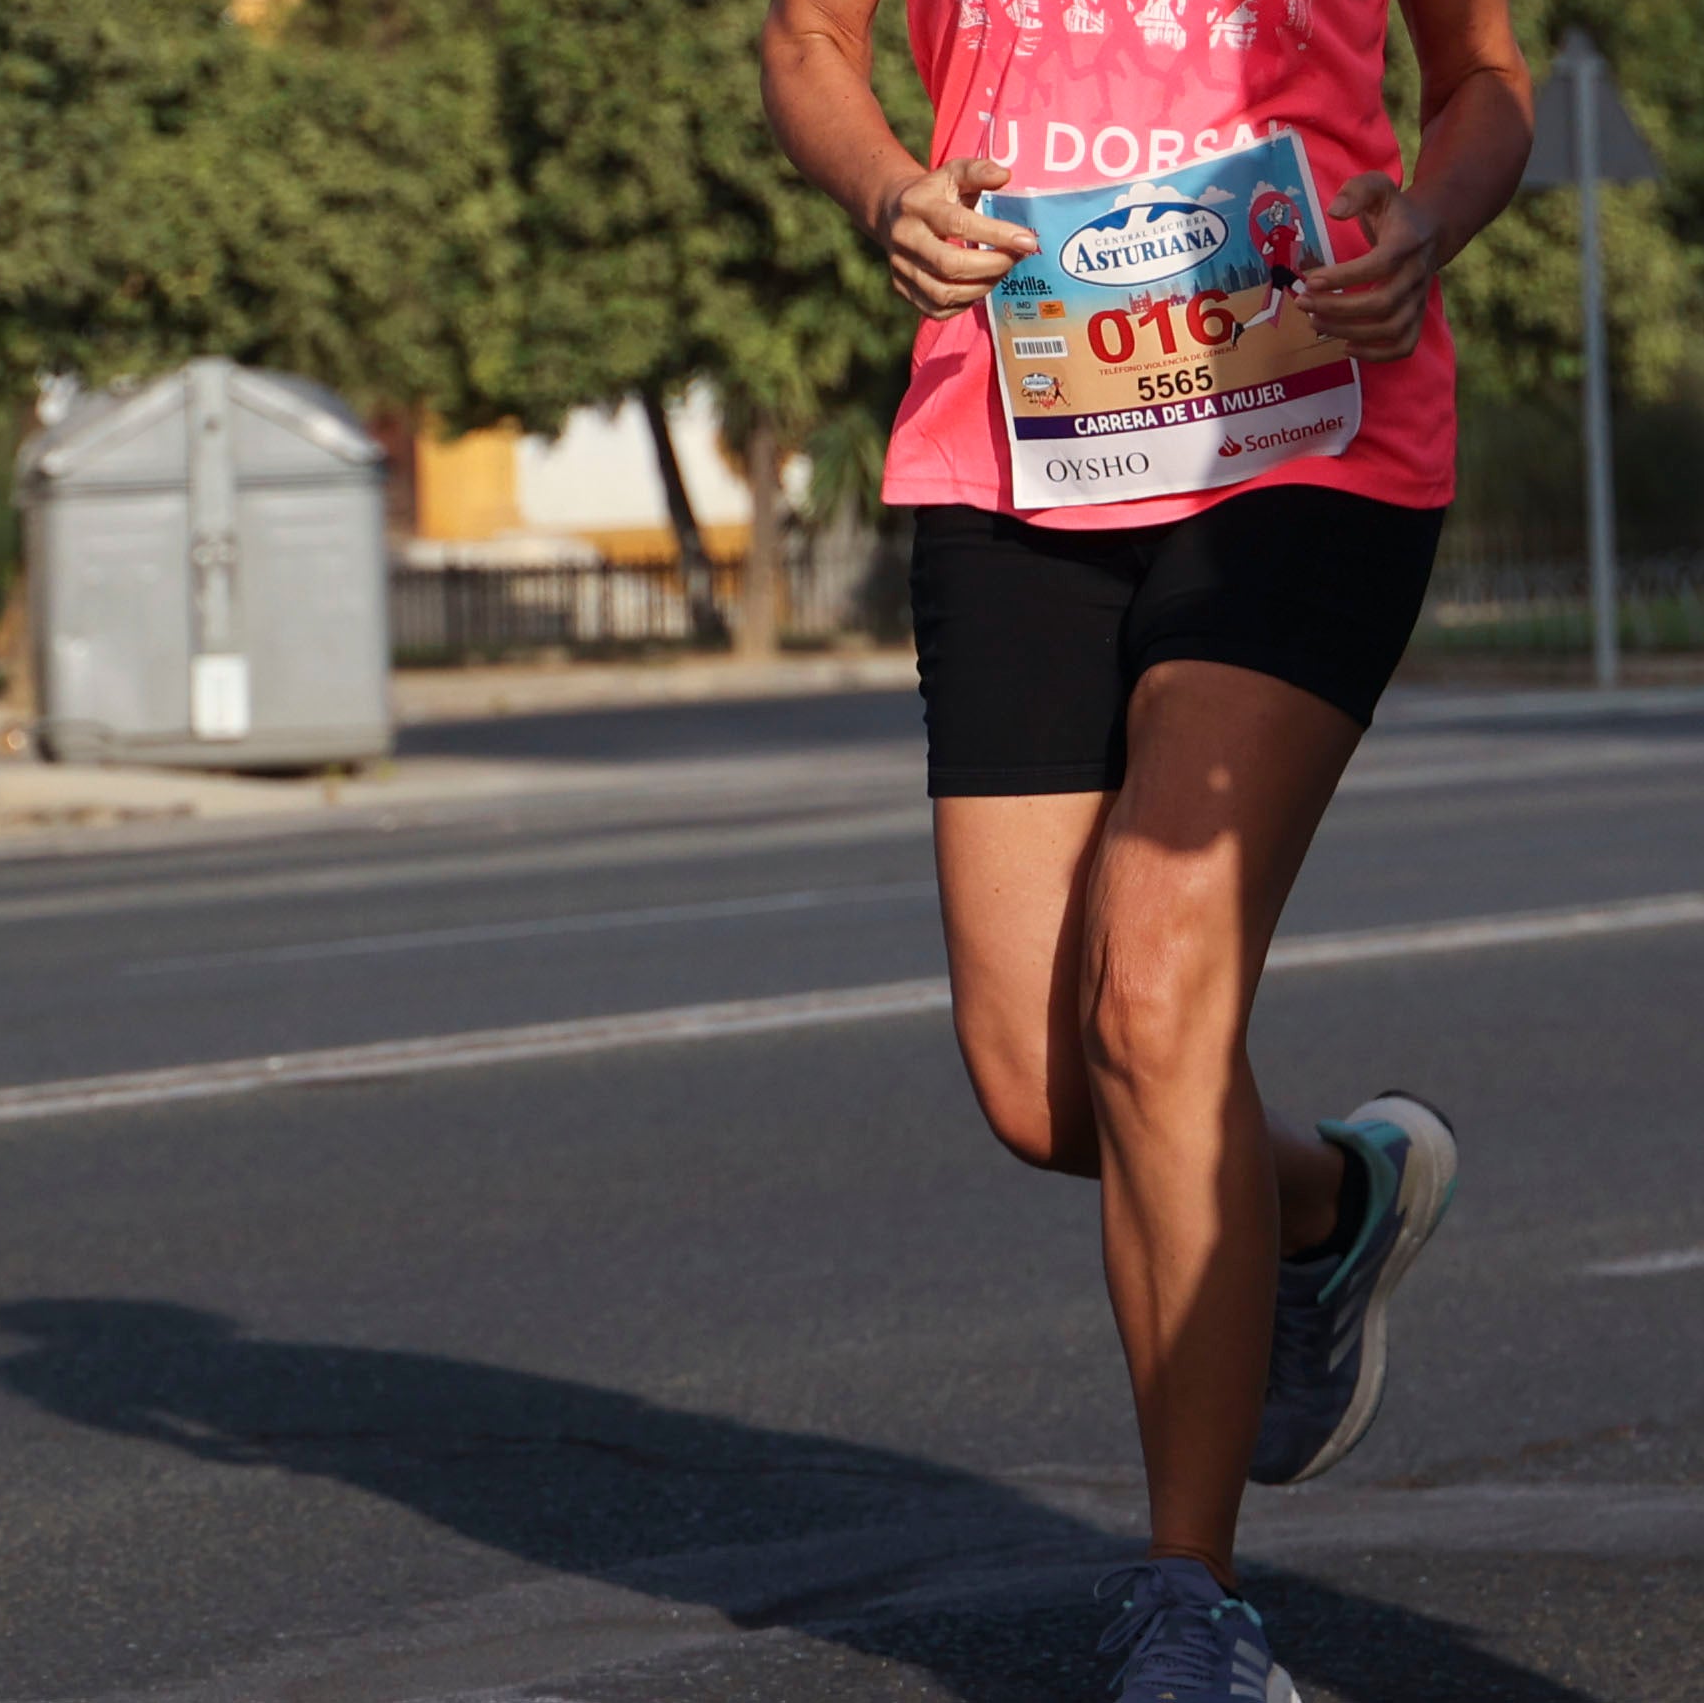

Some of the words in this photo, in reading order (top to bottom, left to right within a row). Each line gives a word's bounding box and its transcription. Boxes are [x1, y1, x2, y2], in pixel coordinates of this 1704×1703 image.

[1094, 230, 1147, 247] CENTRAL
[1153, 215, 1208, 234] LECHERA
[1074, 226, 1219, 274] ASTURIANA
[1087, 289, 1236, 364] 016
[1098, 364, 1143, 376] TELÉFONO
[1144, 355, 1189, 370] VIOLENCIA
[1190, 353, 1202, 361] DE
[1203, 346, 1239, 359] GÉNERO
[1138, 364, 1213, 401] 5565
[1073, 408, 1158, 436] CARRERA
[1162, 403, 1188, 425] DE
[1191, 399, 1217, 419] LA
[1221, 382, 1286, 413] MUJER
[1244, 415, 1345, 453] Santander
[1046, 451, 1150, 484] OYSHO
